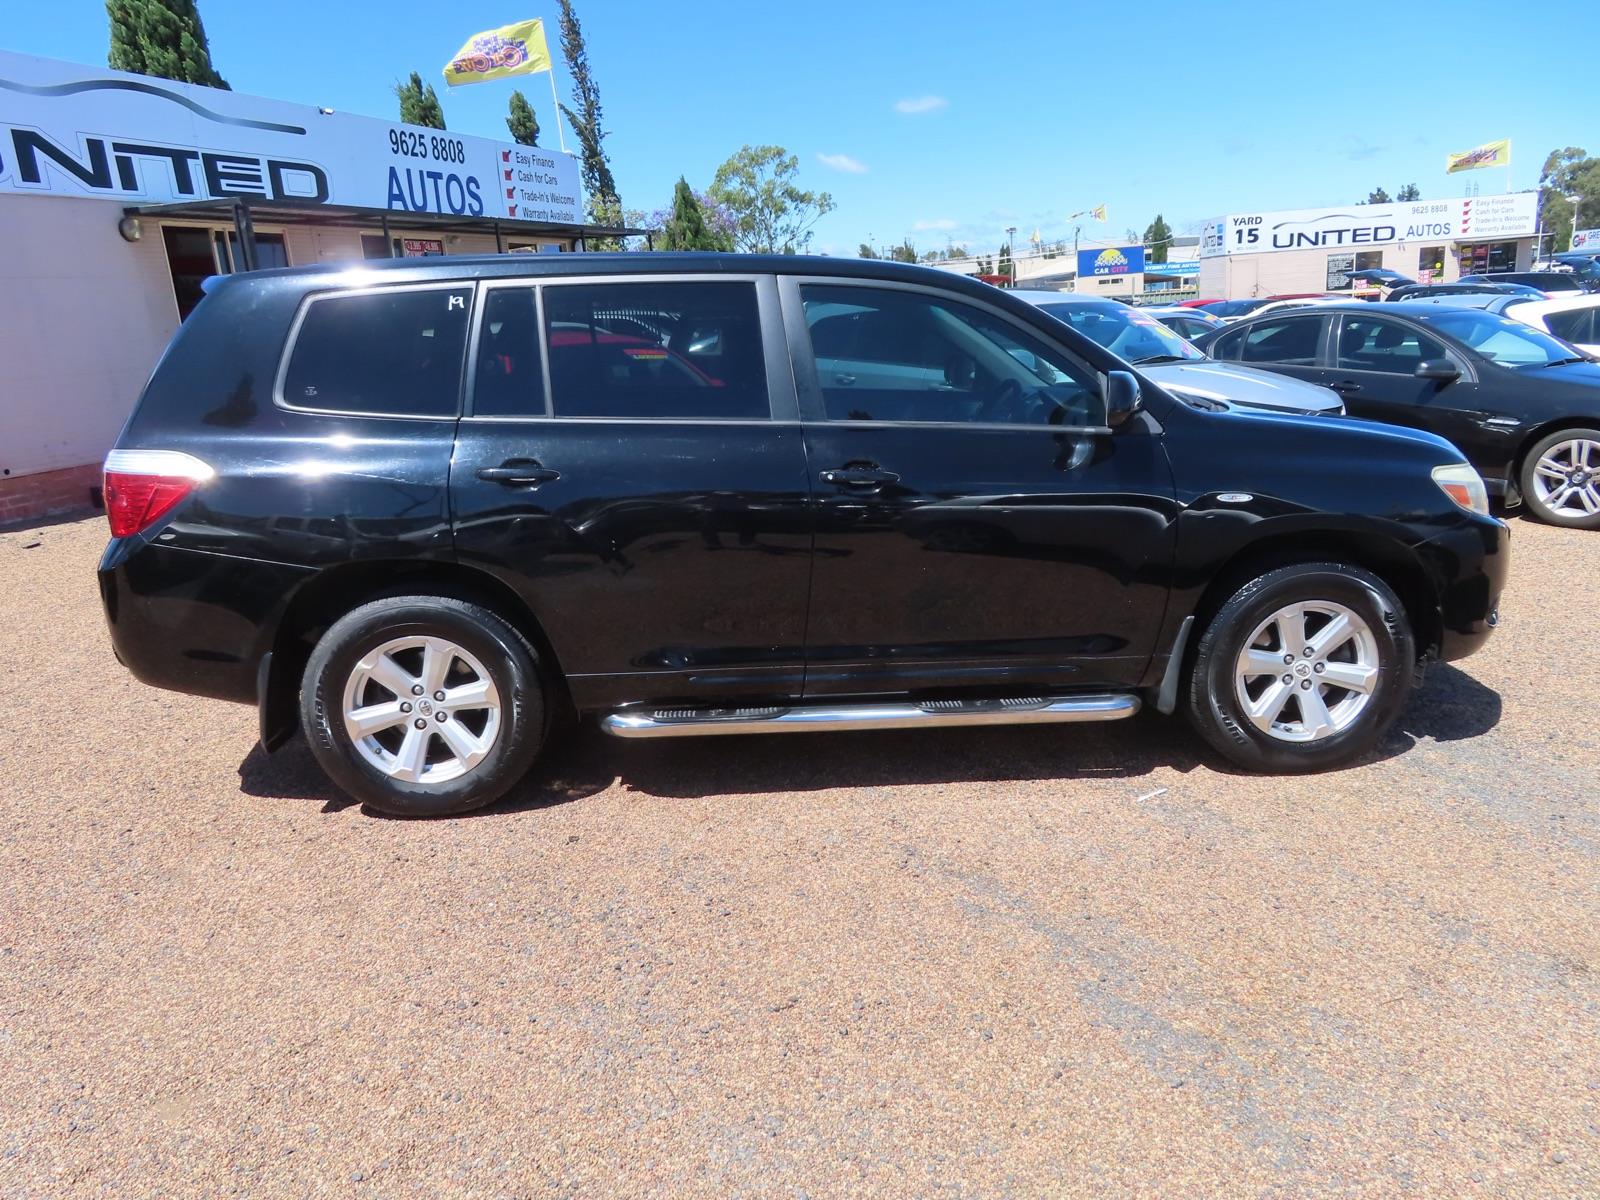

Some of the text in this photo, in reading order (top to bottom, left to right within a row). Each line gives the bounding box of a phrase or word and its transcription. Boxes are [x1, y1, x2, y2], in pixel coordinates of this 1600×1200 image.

[389, 128, 465, 164] 9625 8808
[0, 128, 329, 204] NITED
[515, 152, 555, 169] Easy Finance
[517, 170, 558, 186] Cash for Cars
[387, 166, 484, 217] AUTOS
[520, 189, 575, 205] Trade-In's Welcome
[522, 207, 575, 222] Warranty Available
[1411, 206, 1429, 215] 9625
[1233, 216, 1263, 226] YARD
[1235, 228, 1260, 244] 15
[1406, 222, 1451, 237] AUTOS
[1094, 267, 1110, 275] CAR
